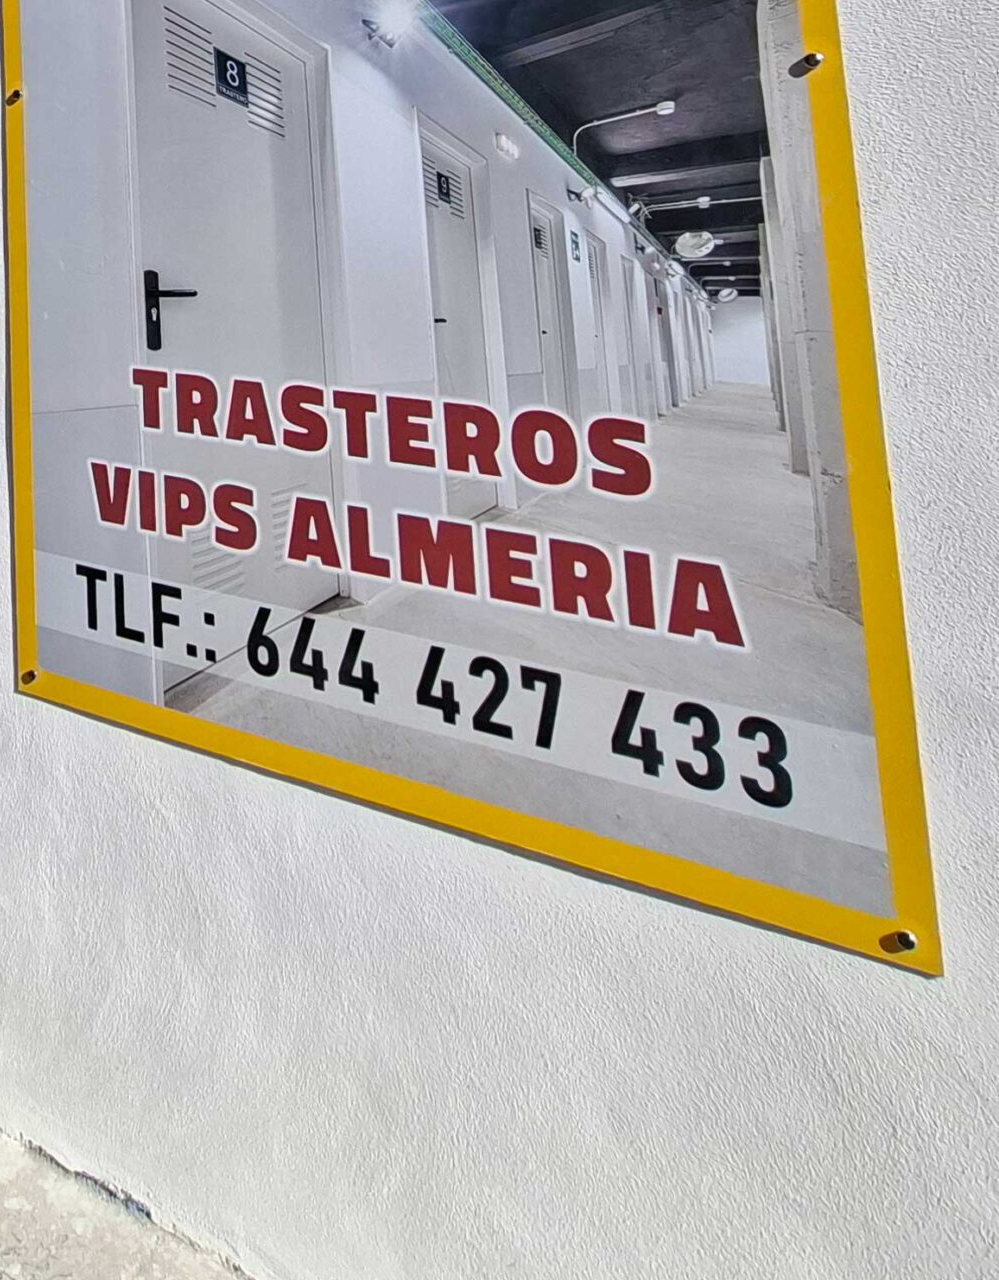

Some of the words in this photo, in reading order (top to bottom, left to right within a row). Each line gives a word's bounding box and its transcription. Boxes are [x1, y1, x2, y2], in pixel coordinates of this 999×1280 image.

[226, 60, 239, 86] 8
[132, 368, 651, 496] TRASTEROS
[90, 462, 257, 551] VIPS
[287, 498, 745, 647] ALMERIA
[75, 564, 216, 663] TLF.:
[247, 607, 380, 704] 644
[415, 645, 562, 749] 427
[611, 689, 794, 808] 433
